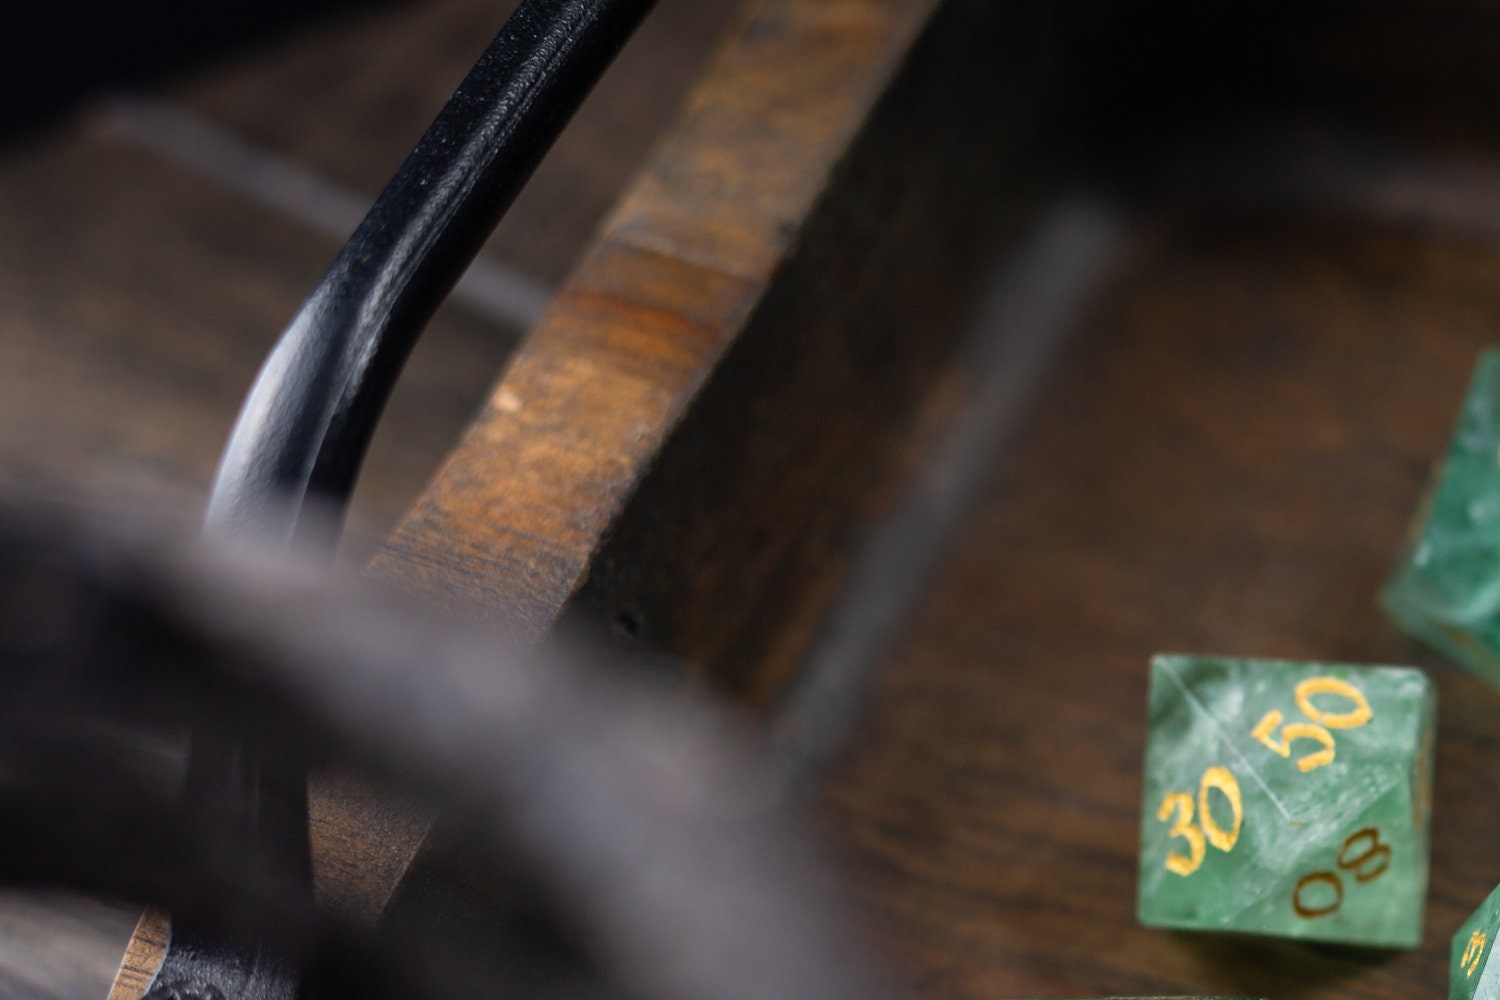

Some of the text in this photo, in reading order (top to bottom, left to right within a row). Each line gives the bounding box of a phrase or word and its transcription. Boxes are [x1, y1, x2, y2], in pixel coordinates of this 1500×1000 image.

[1252, 677, 1373, 772] 50
[1158, 766, 1243, 876] 30
[1292, 827, 1392, 919] 80
